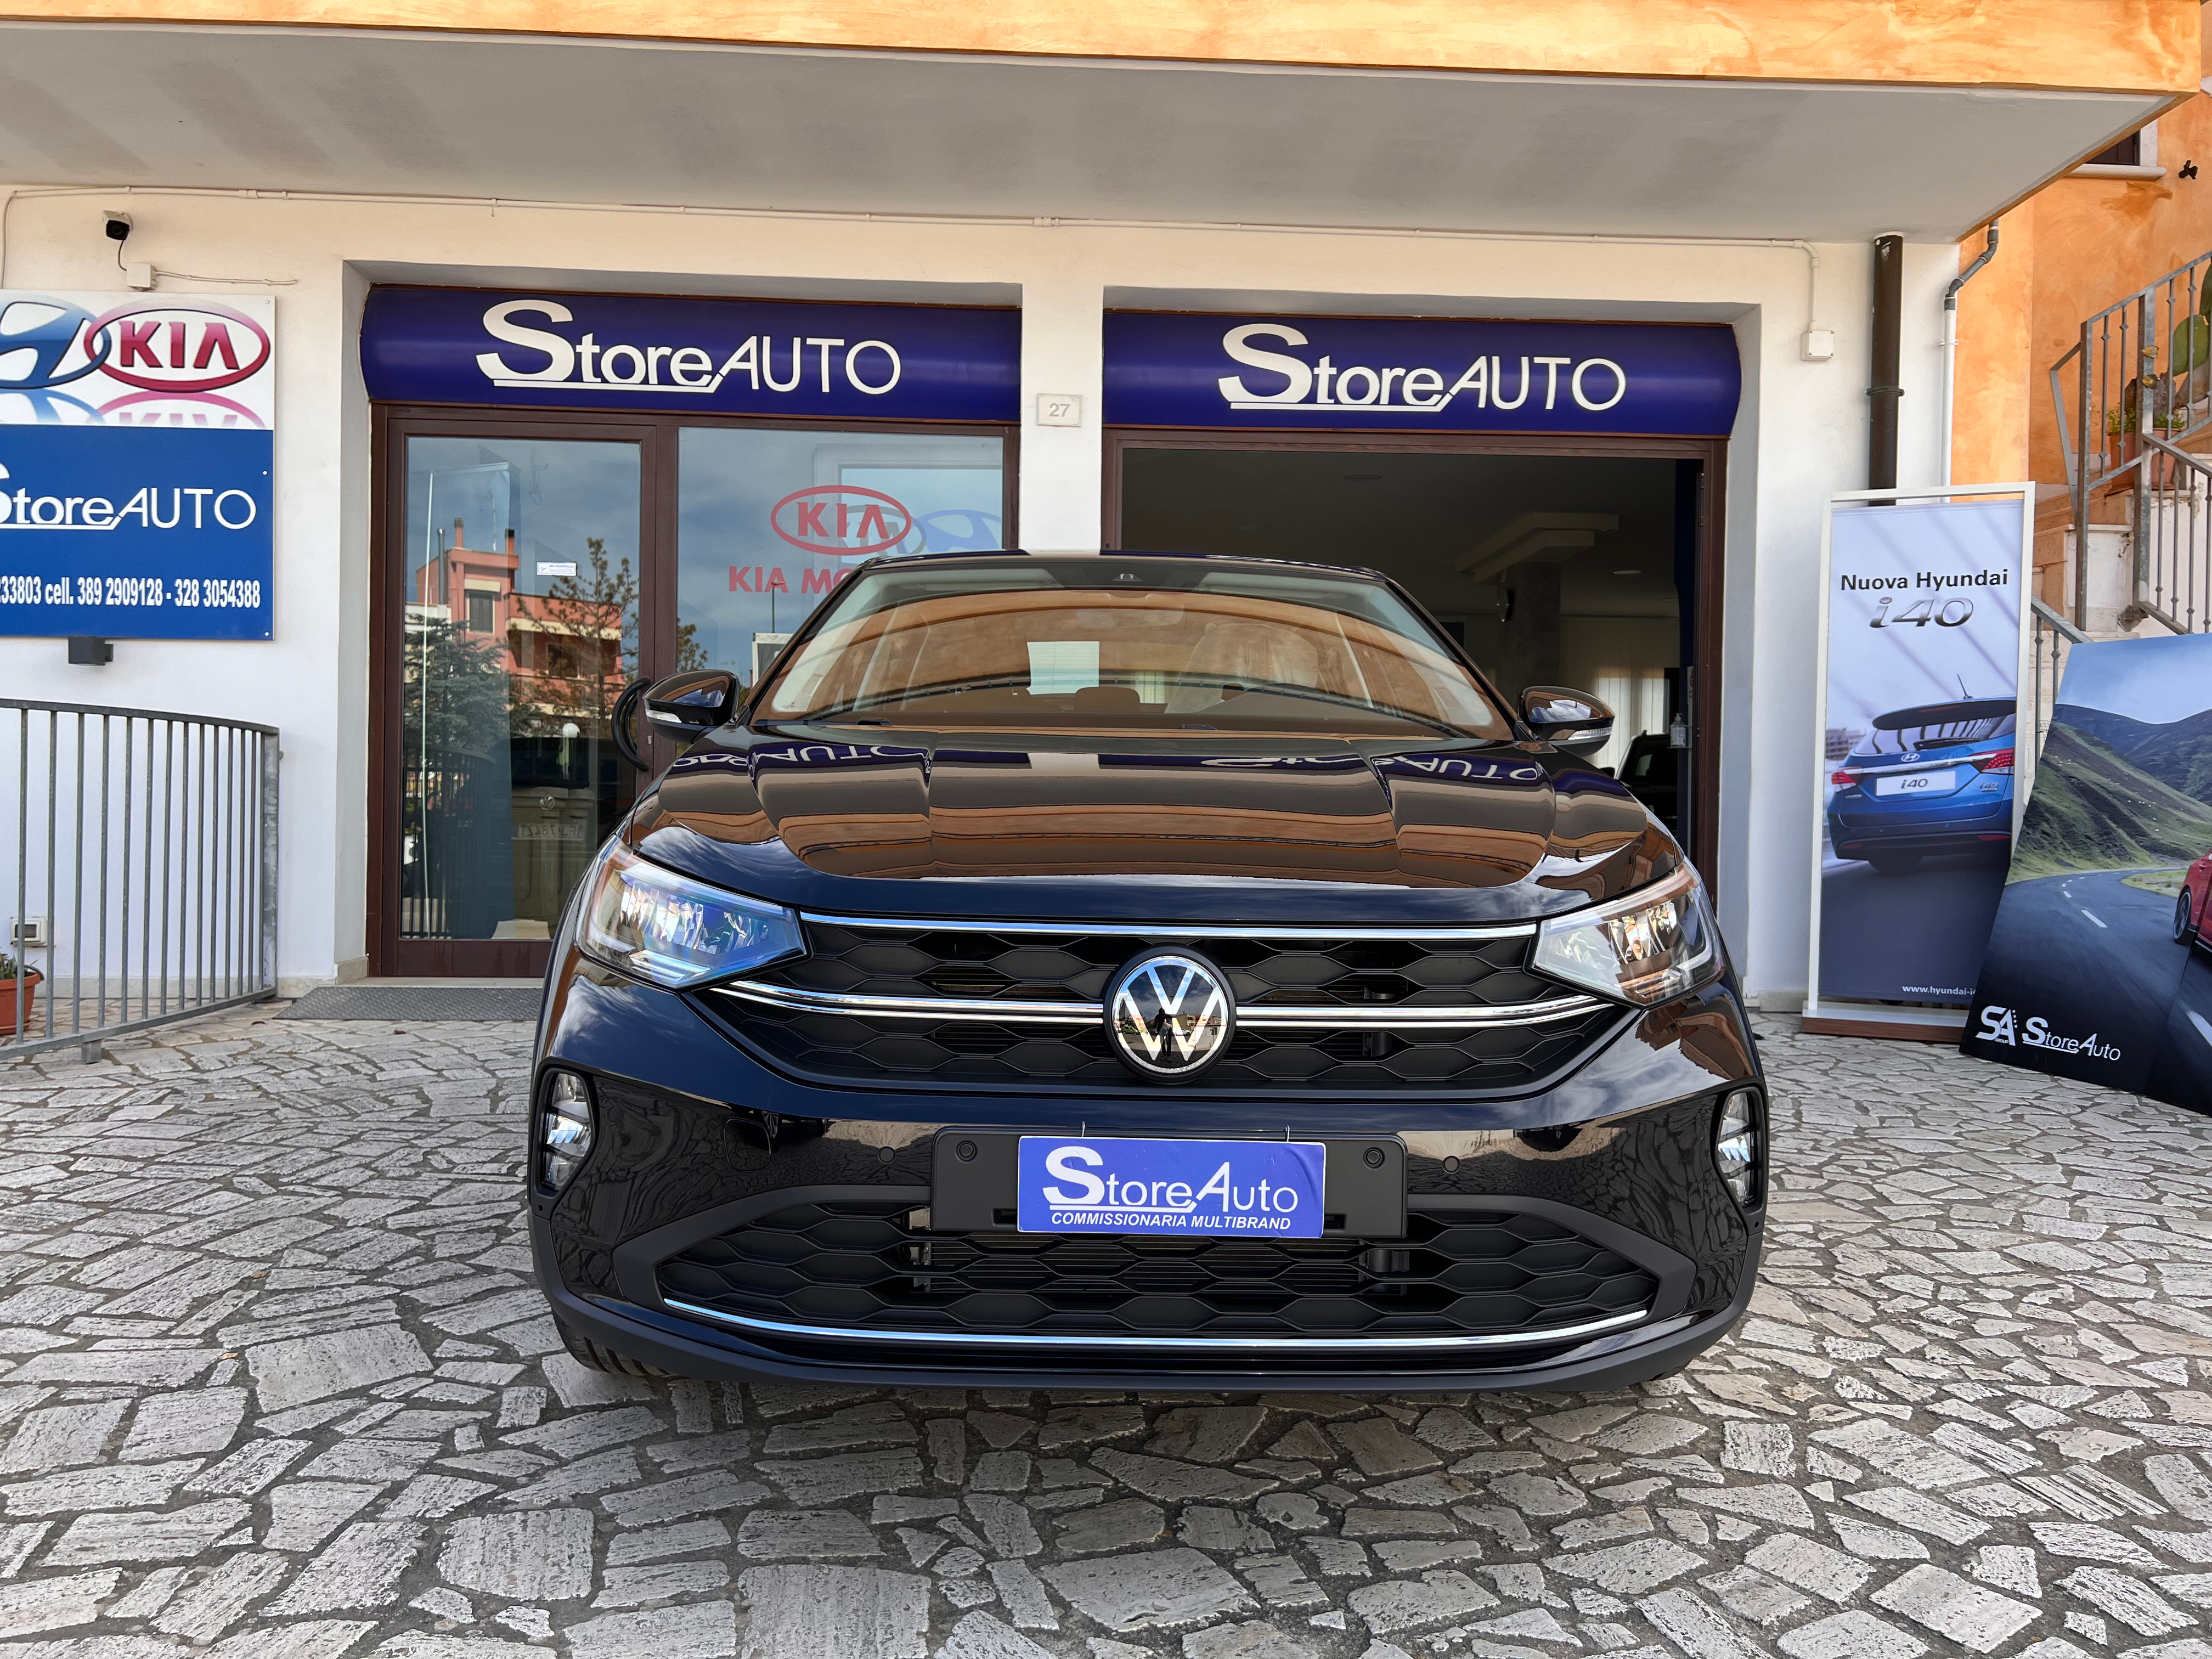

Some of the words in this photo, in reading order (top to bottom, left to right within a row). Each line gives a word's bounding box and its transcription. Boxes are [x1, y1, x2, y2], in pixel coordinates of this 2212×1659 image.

[119, 320, 240, 370] KIA
[1049, 403, 1070, 417] 27
[796, 501, 890, 539] KIA
[0, 574, 42, 605] 33803
[45, 576, 74, 605] cell.
[77, 576, 103, 606] 389
[105, 577, 163, 607] 2909128
[174, 578, 200, 608] 328
[203, 578, 261, 609] 3054388
[729, 565, 789, 594] KIA
[1841, 574, 1909, 590] Nuova
[1916, 568, 2008, 591] Hyundai
[1870, 596, 1974, 629] i40
[1900, 778, 1929, 790] i40
[1051, 1211, 1187, 1228] COMMISSIONARIA
[1190, 1215, 1291, 1230] MULTIBRAND
